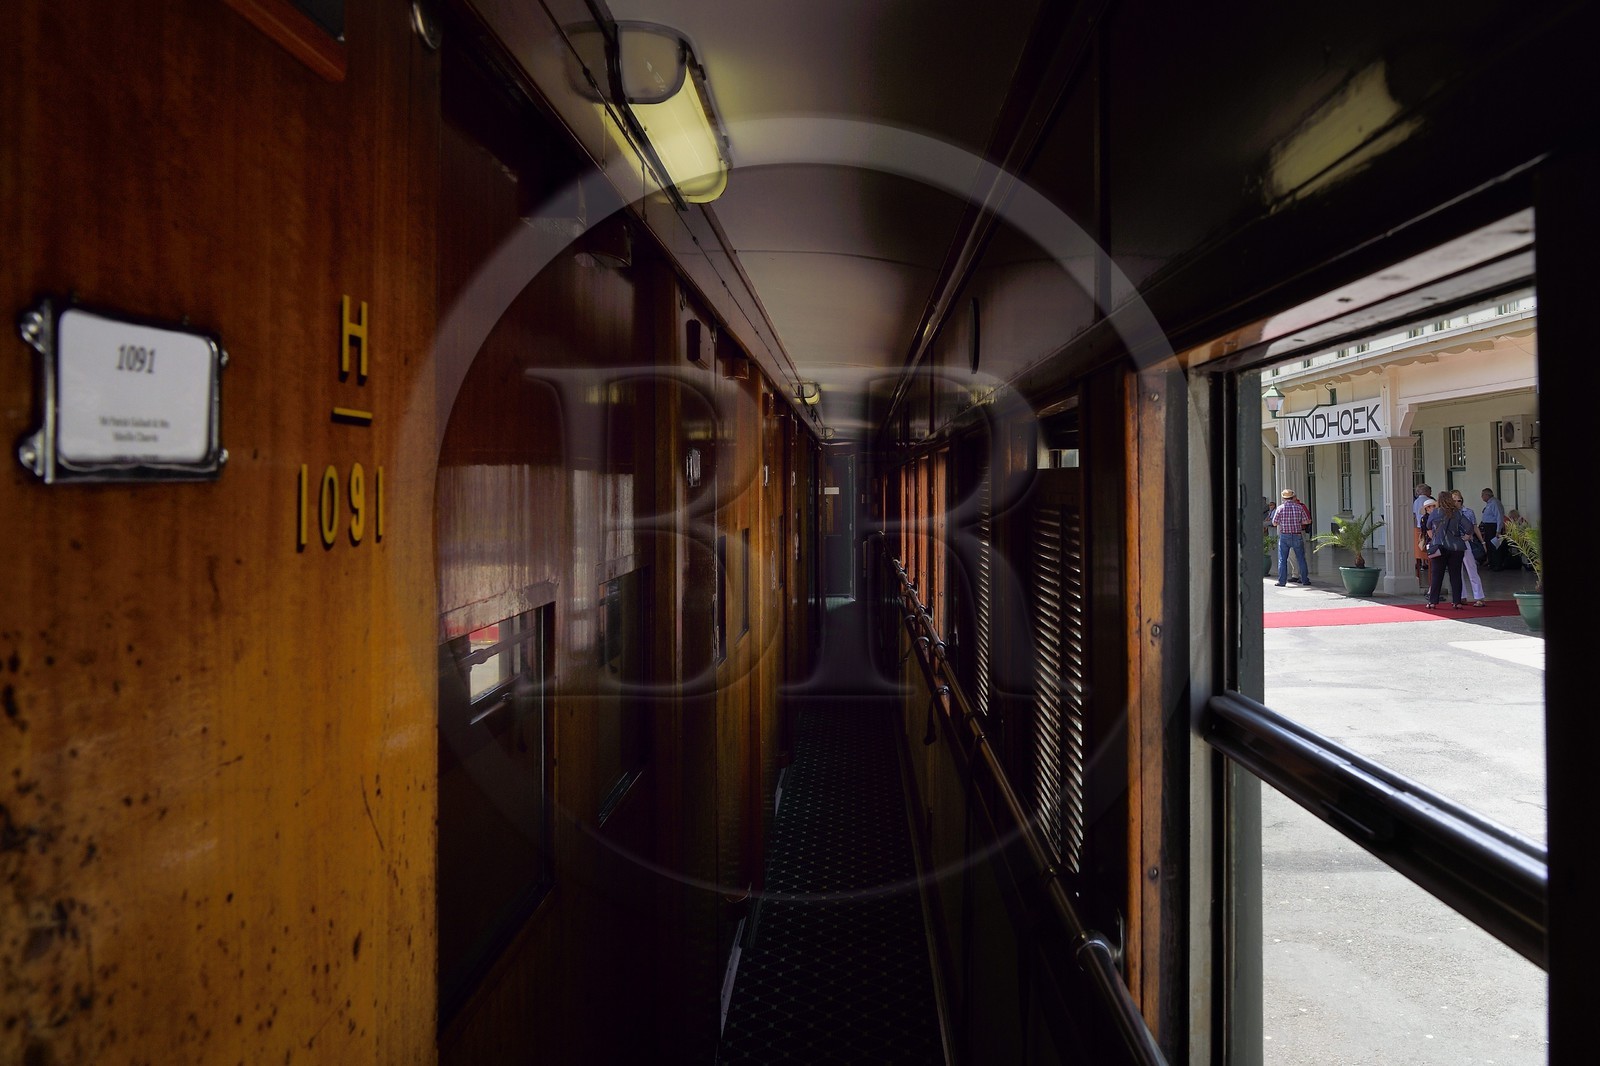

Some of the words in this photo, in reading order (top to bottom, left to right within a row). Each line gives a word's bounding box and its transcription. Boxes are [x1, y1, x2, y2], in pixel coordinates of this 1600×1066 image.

[116, 344, 156, 375] 1091
[342, 295, 369, 377] H
[1287, 404, 1381, 441] WINDHOEK
[299, 463, 384, 546] 1091
